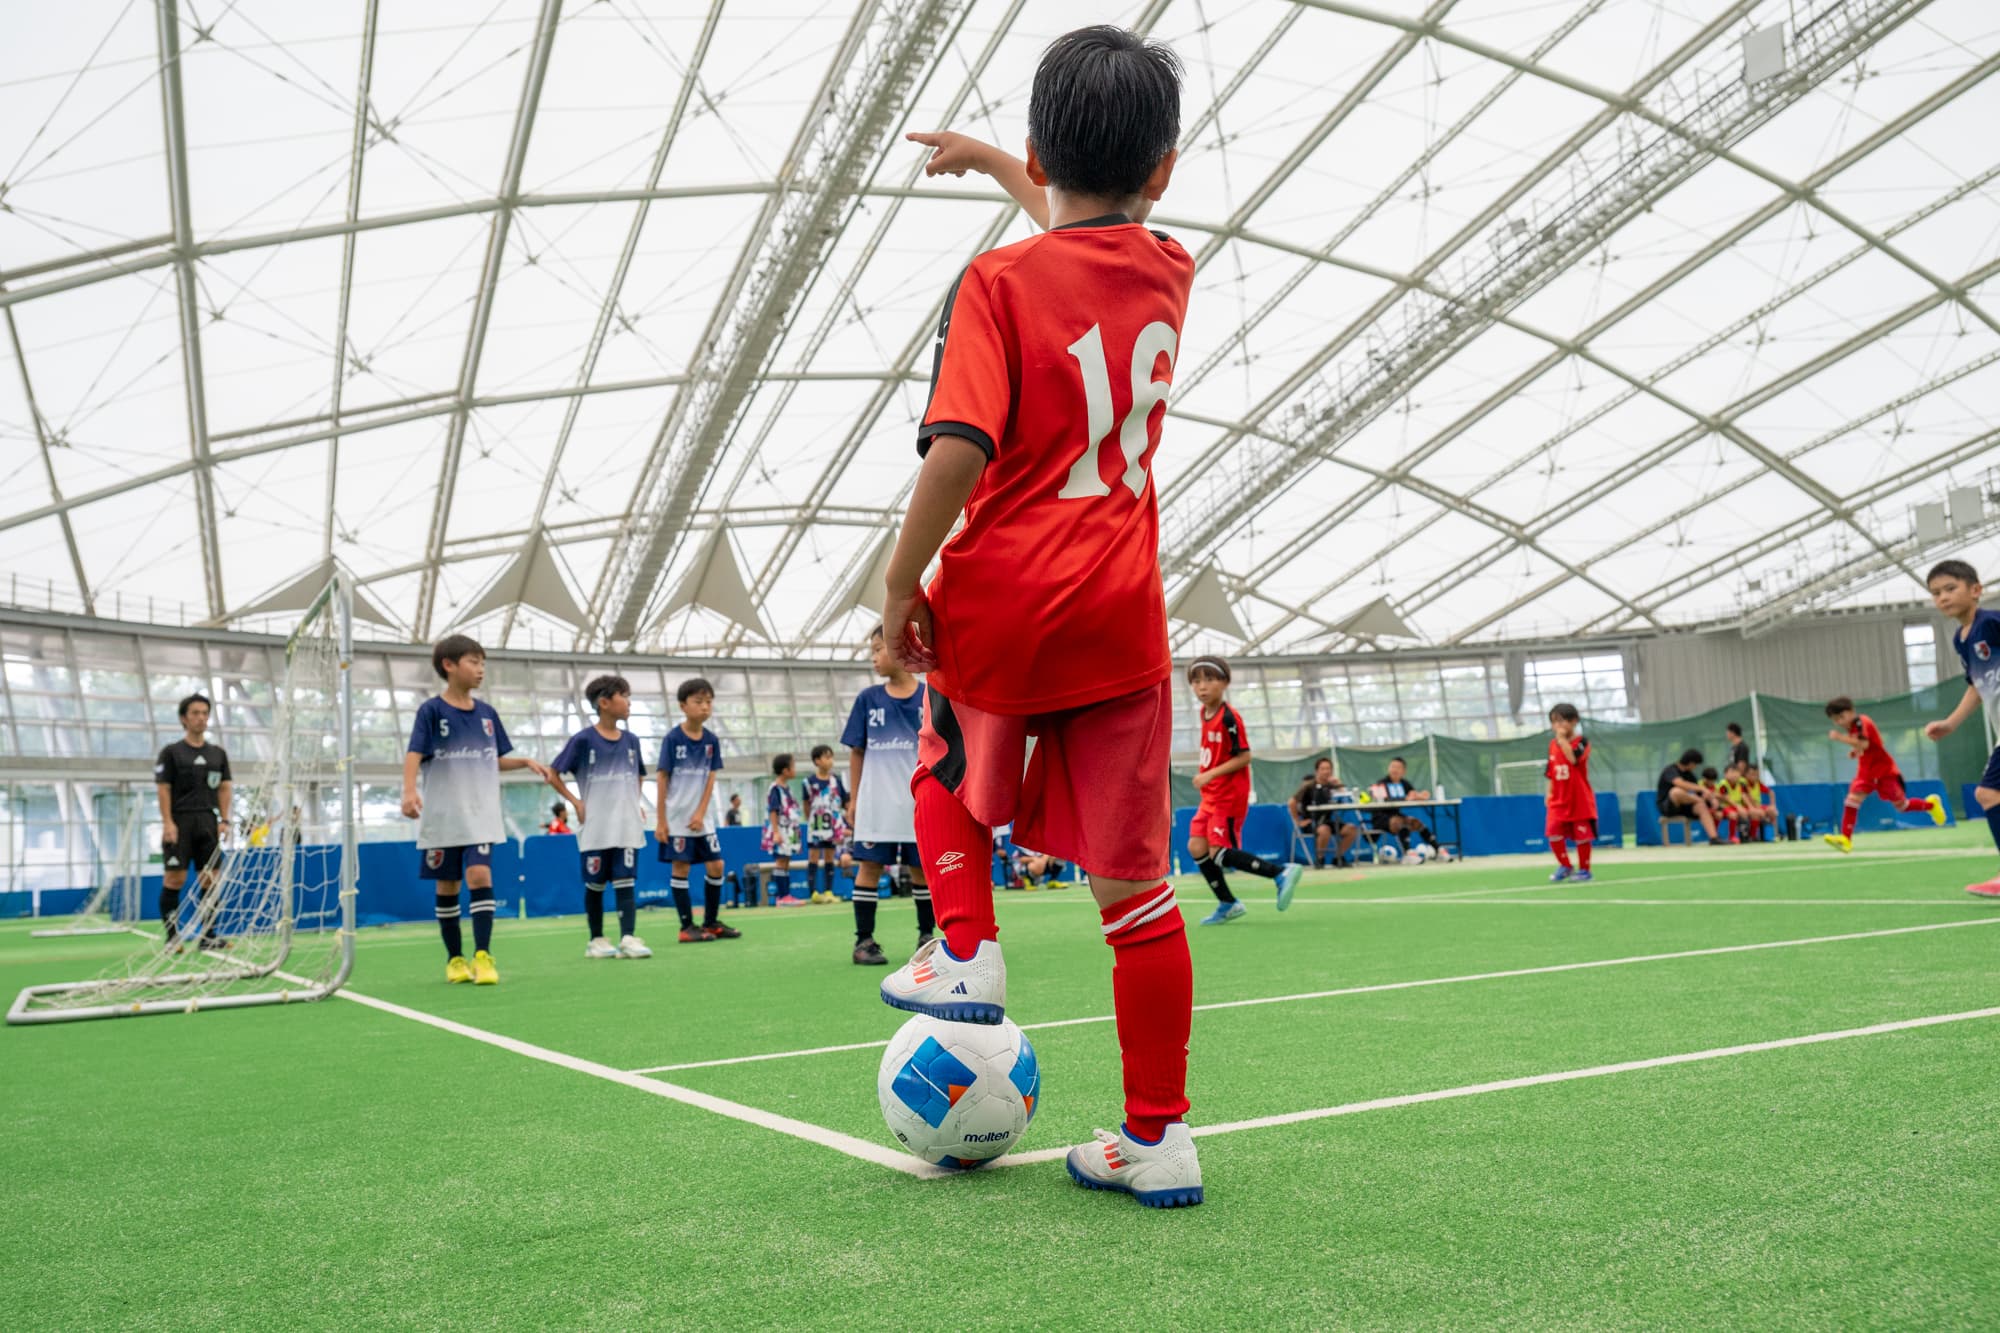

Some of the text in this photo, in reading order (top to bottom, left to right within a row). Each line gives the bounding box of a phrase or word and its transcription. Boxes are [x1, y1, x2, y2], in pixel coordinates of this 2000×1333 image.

[868, 708, 885, 727] 24
[439, 718, 449, 737] 5
[814, 812, 832, 831] 19
[623, 847, 635, 868] 6
[940, 863, 963, 875] umbro
[963, 1130, 1010, 1143] molten
